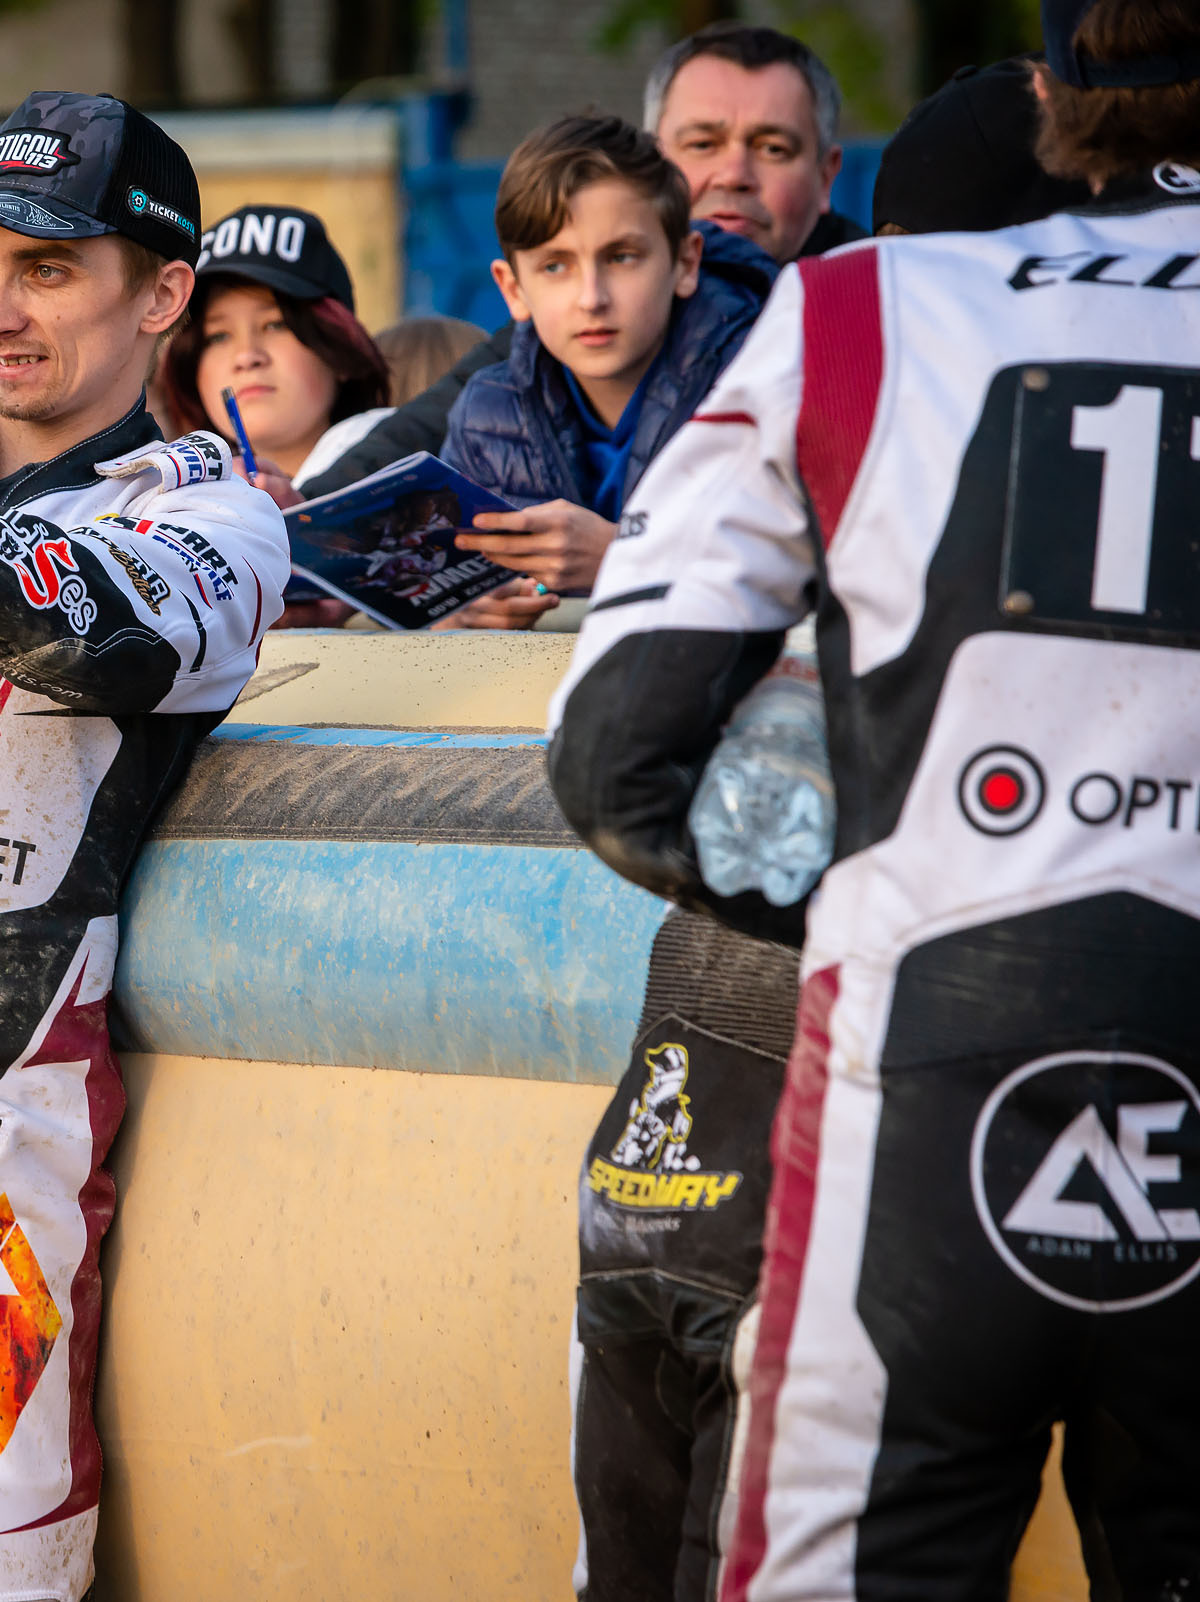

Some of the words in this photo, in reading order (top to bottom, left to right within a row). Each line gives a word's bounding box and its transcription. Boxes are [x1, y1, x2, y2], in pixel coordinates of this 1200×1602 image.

[26, 152, 58, 169] 113
[196, 213, 305, 263] ONO
[1007, 251, 1200, 291] ELL
[1070, 384, 1200, 615] 1
[1070, 773, 1200, 831] OPT
[590, 1157, 740, 1207] SPEEDWAY
[1026, 1236, 1092, 1259] ADAM
[1113, 1243, 1178, 1262] ELLIS
